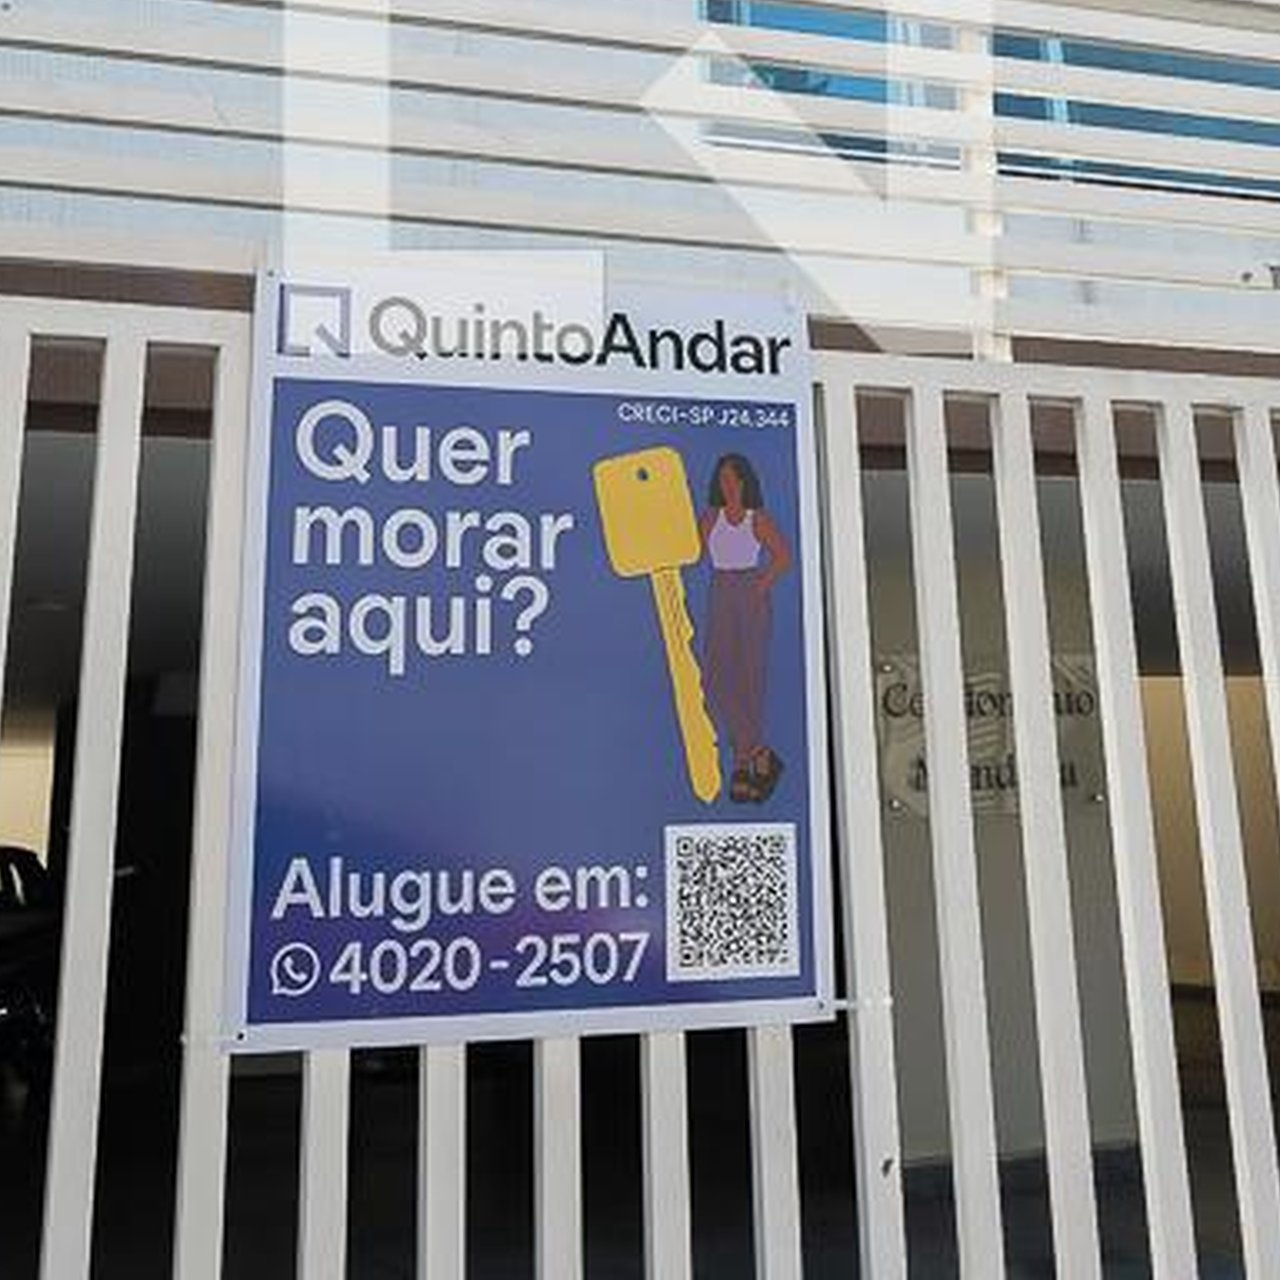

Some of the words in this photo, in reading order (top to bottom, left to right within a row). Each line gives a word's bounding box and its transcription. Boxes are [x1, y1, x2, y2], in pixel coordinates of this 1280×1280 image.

[368, 296, 792, 377] QuintoAndar
[295, 400, 531, 485] Quer
[616, 402, 715, 426] CRECI-SP
[293, 506, 574, 570] morar
[289, 574, 549, 675] aqui?
[271, 856, 517, 933] Alugue
[534, 866, 649, 911] em:
[329, 931, 651, 995] 4020-2507
